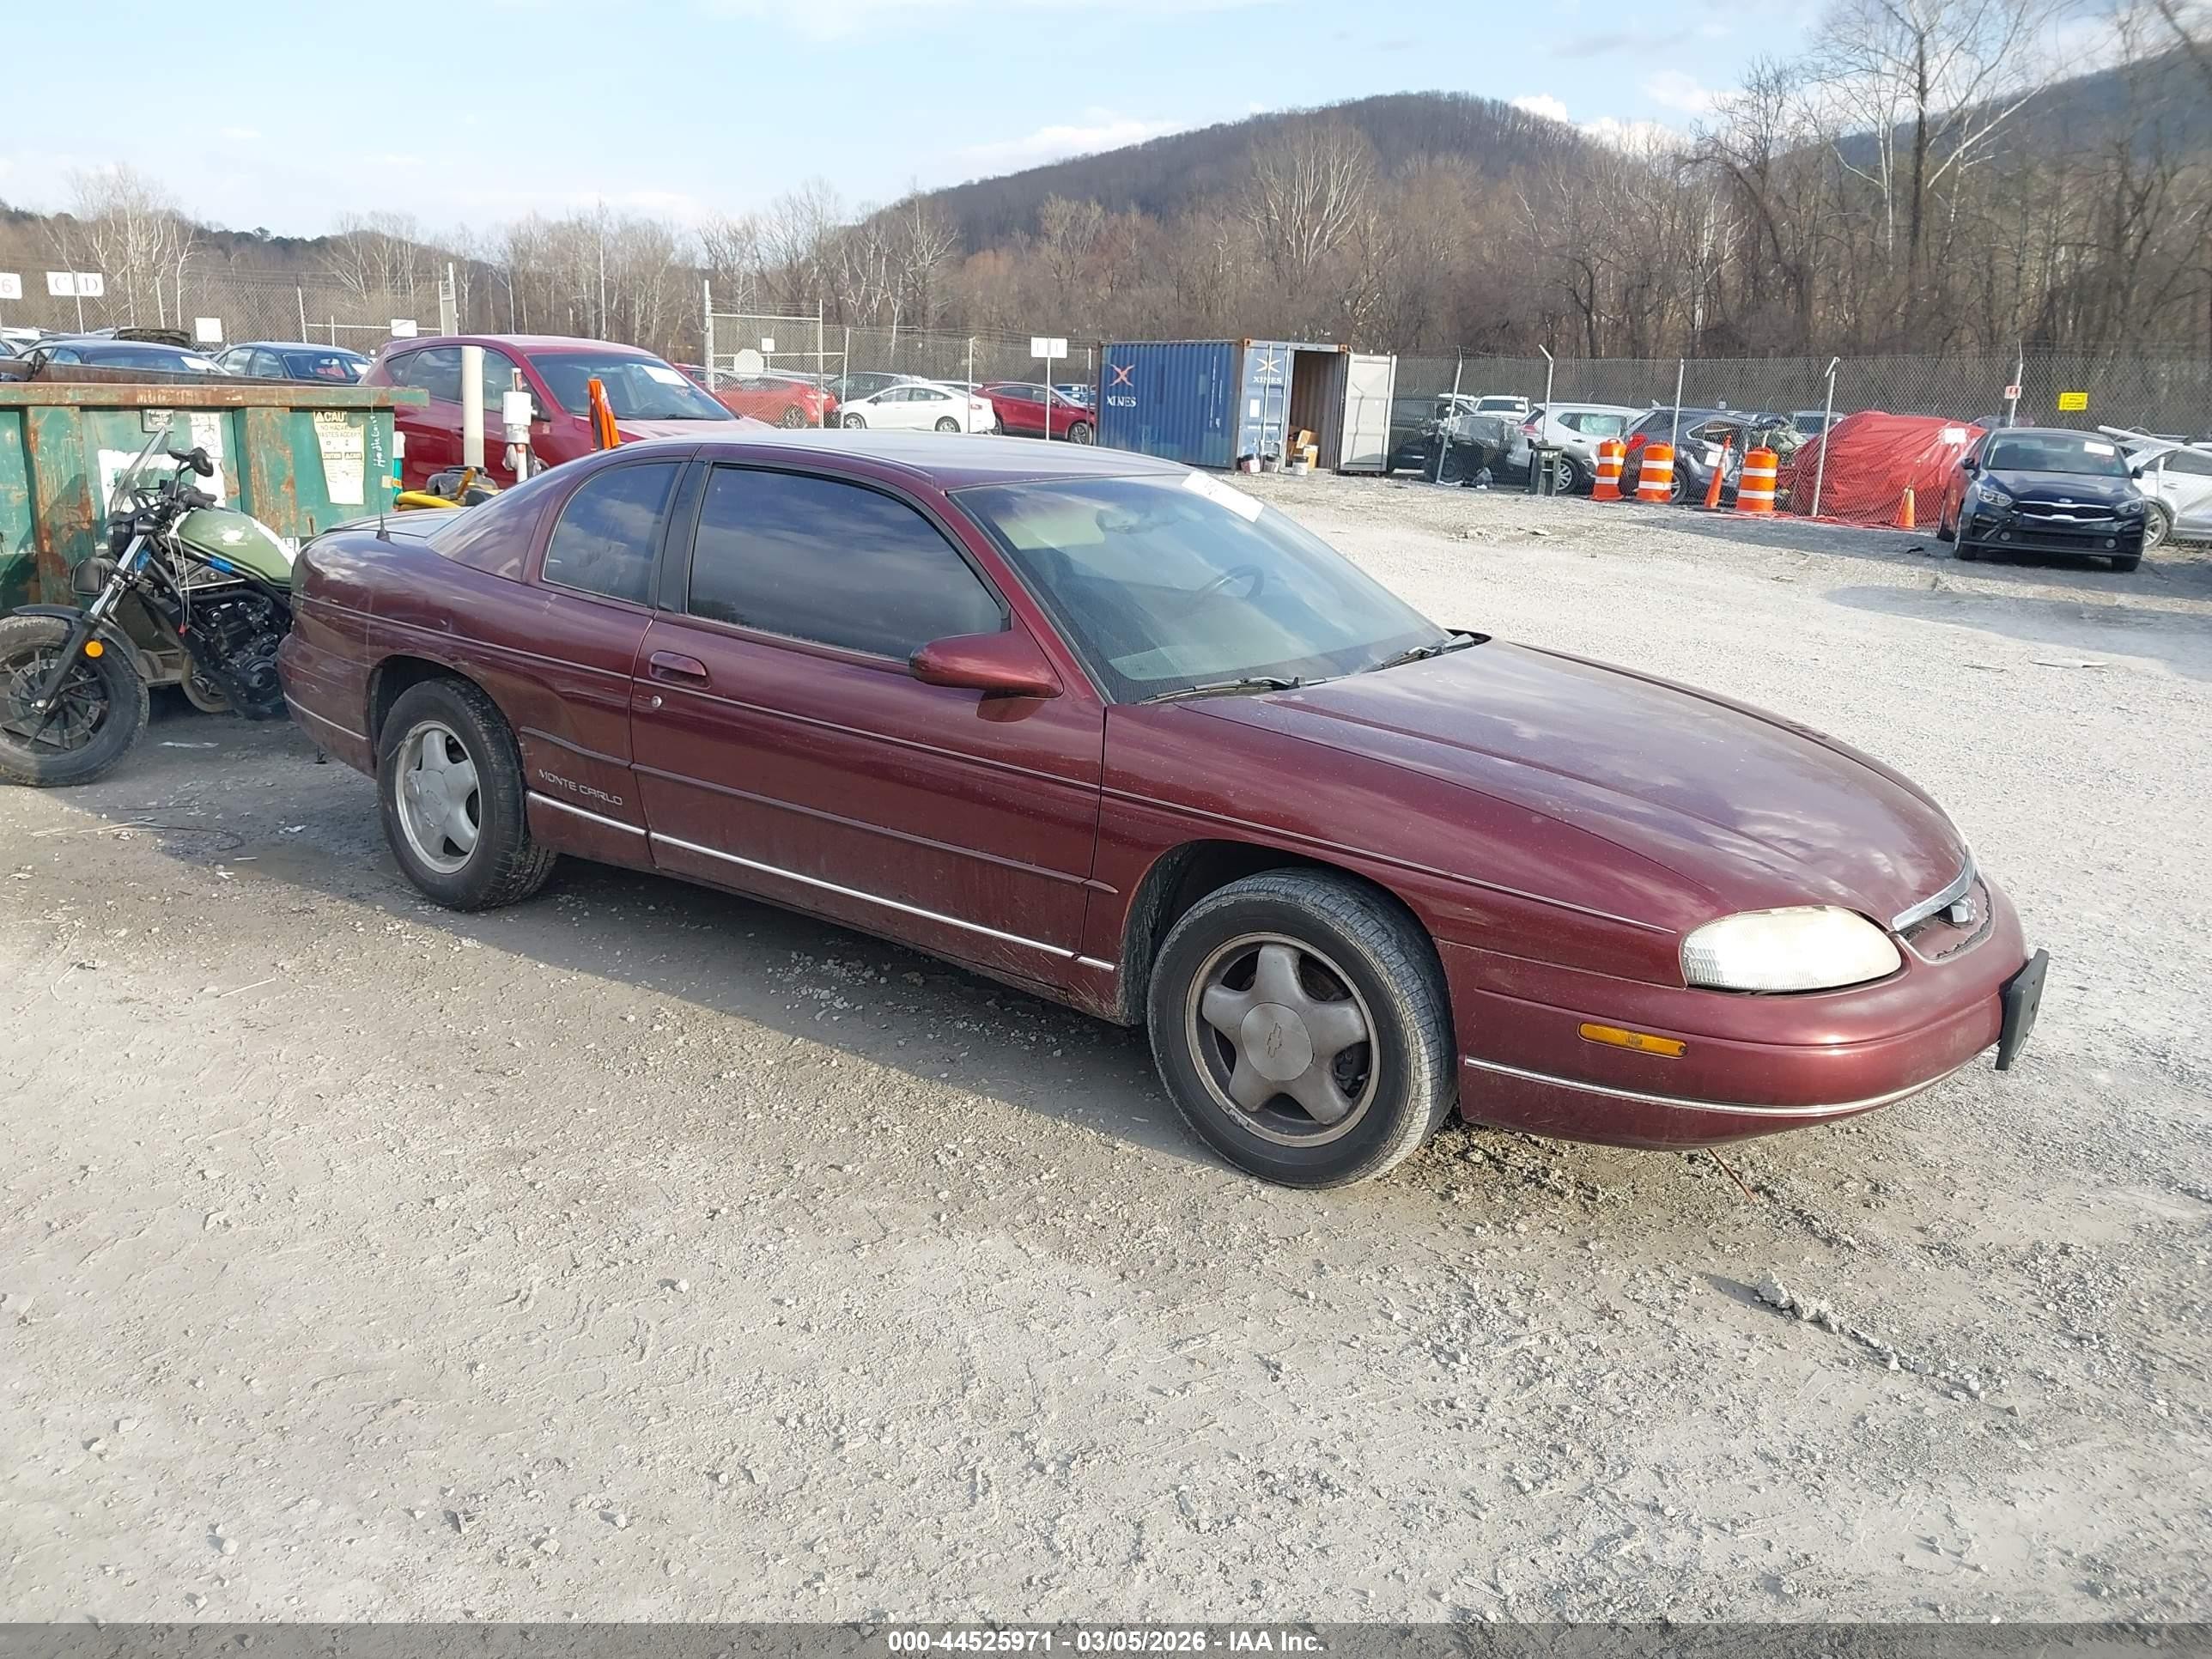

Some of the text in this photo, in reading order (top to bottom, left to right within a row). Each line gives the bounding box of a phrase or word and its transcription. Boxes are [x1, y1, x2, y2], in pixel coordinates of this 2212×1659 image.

[83, 276, 98, 291] D
[1107, 395, 1137, 407] XINES
[324, 411, 347, 422] CAU
[538, 769, 623, 805] MONTE CARLO
